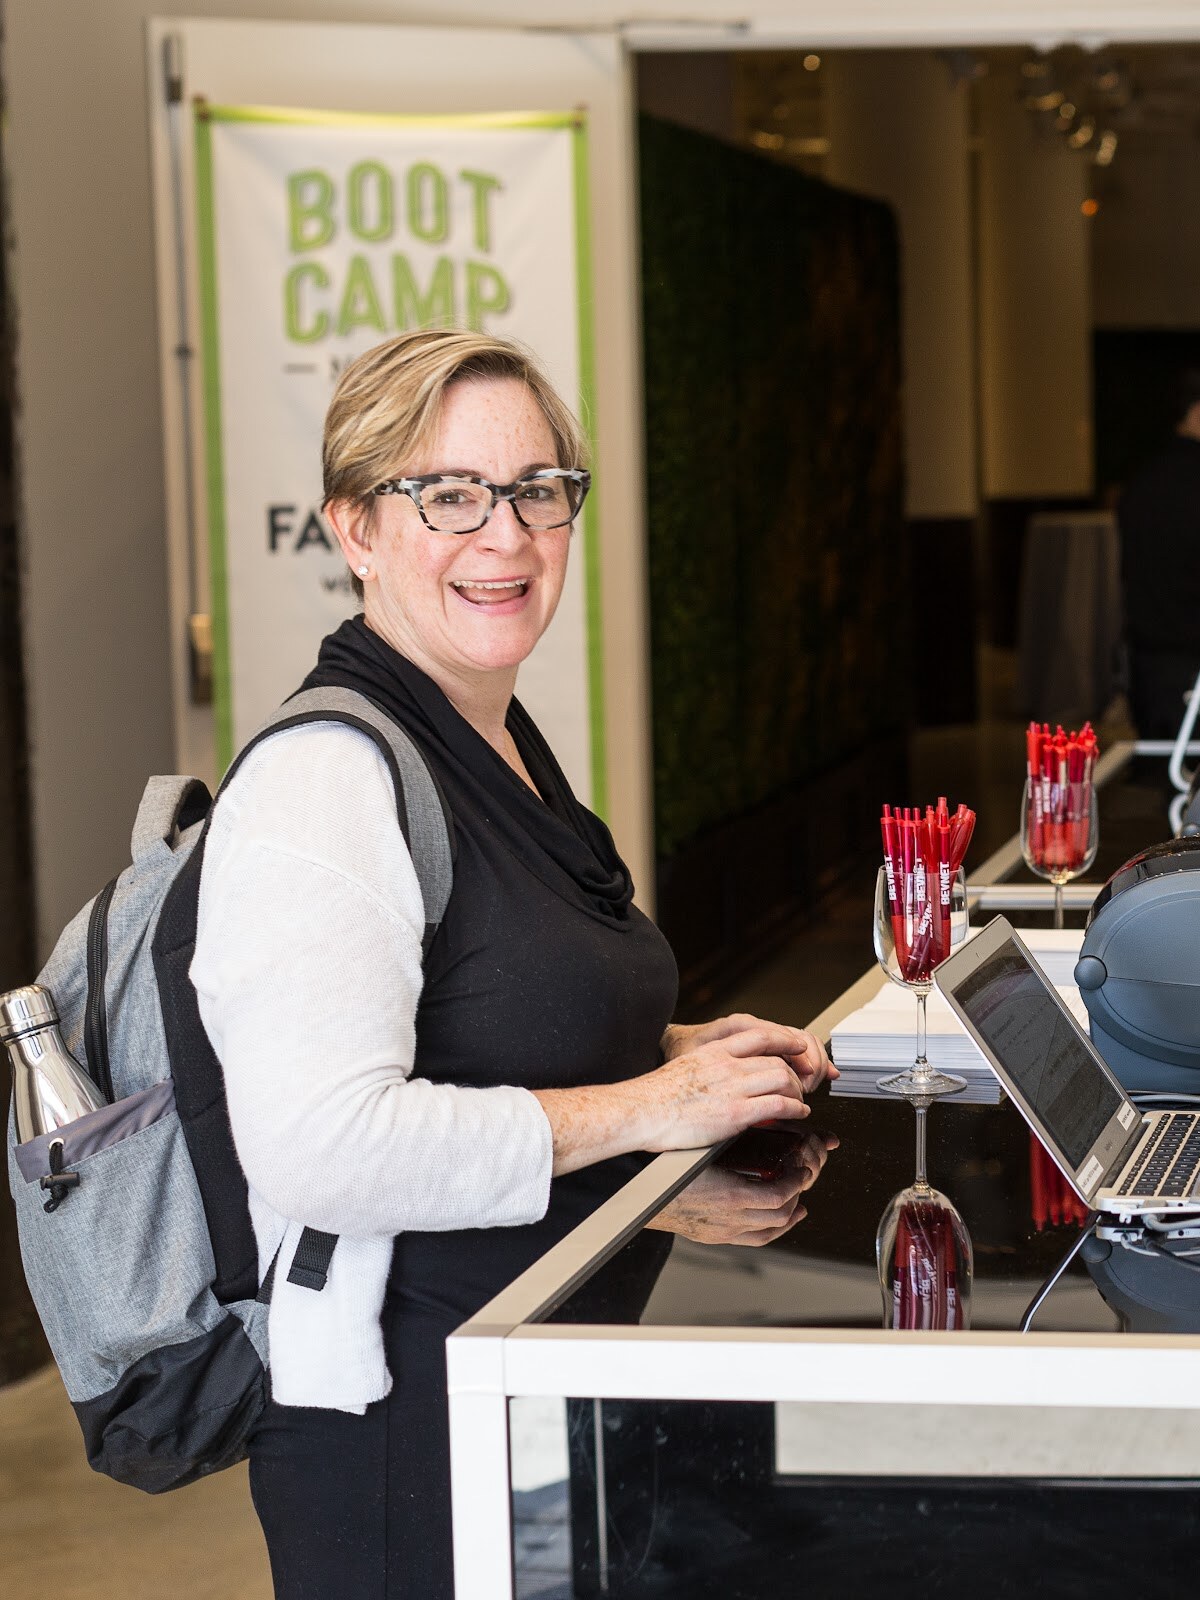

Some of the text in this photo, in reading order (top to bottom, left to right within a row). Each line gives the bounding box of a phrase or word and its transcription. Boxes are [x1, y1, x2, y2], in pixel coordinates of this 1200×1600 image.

[286, 158, 505, 255] BOOT
[283, 251, 511, 346] CAMP
[267, 504, 332, 554] FA
